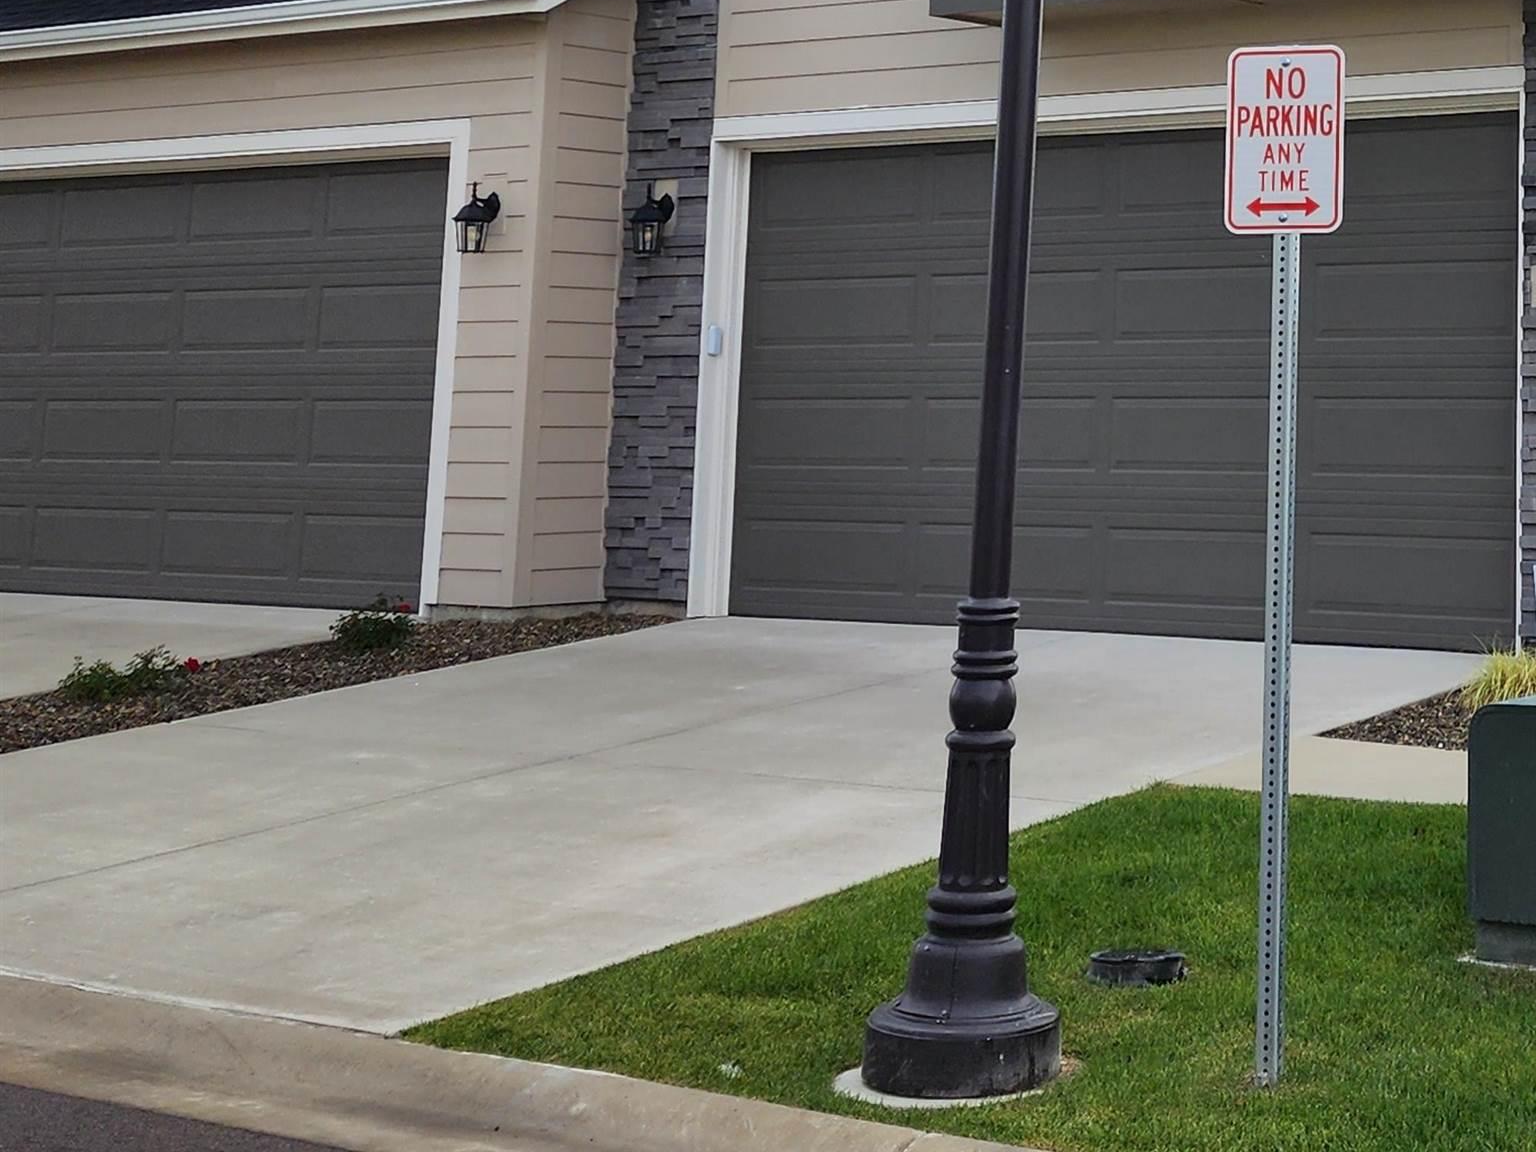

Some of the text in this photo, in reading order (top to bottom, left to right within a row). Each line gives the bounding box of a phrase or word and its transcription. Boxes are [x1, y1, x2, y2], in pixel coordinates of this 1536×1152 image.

[1266, 68, 1305, 99] NO
[1237, 104, 1333, 137] PARKING
[1263, 143, 1305, 164] ANY
[1258, 170, 1309, 191] TIME
